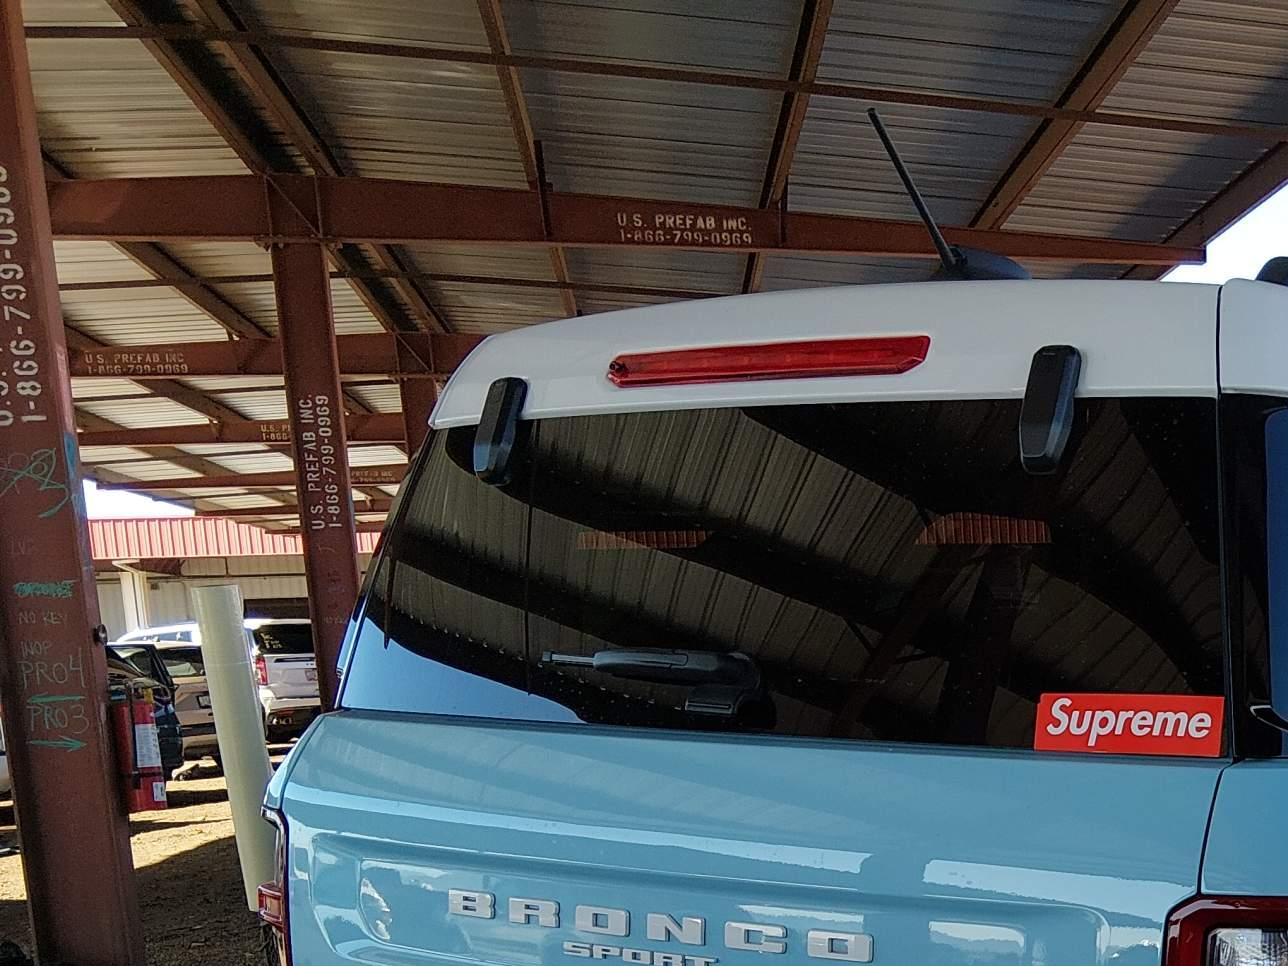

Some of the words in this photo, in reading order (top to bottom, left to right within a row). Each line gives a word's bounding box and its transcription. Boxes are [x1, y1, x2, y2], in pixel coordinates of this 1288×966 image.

[617, 212, 648, 227] U.S.
[655, 213, 716, 230] PREFAB
[723, 217, 752, 231] INC.
[619, 229, 752, 245] 1-866-799-0969
[299, 394, 315, 423] INC.
[302, 431, 321, 492] PREFAB
[315, 395, 343, 528] 1-866-799-0969
[310, 500, 326, 530] U.S.
[1046, 696, 1213, 748] Supreme
[448, 887, 875, 964] BRONCO
